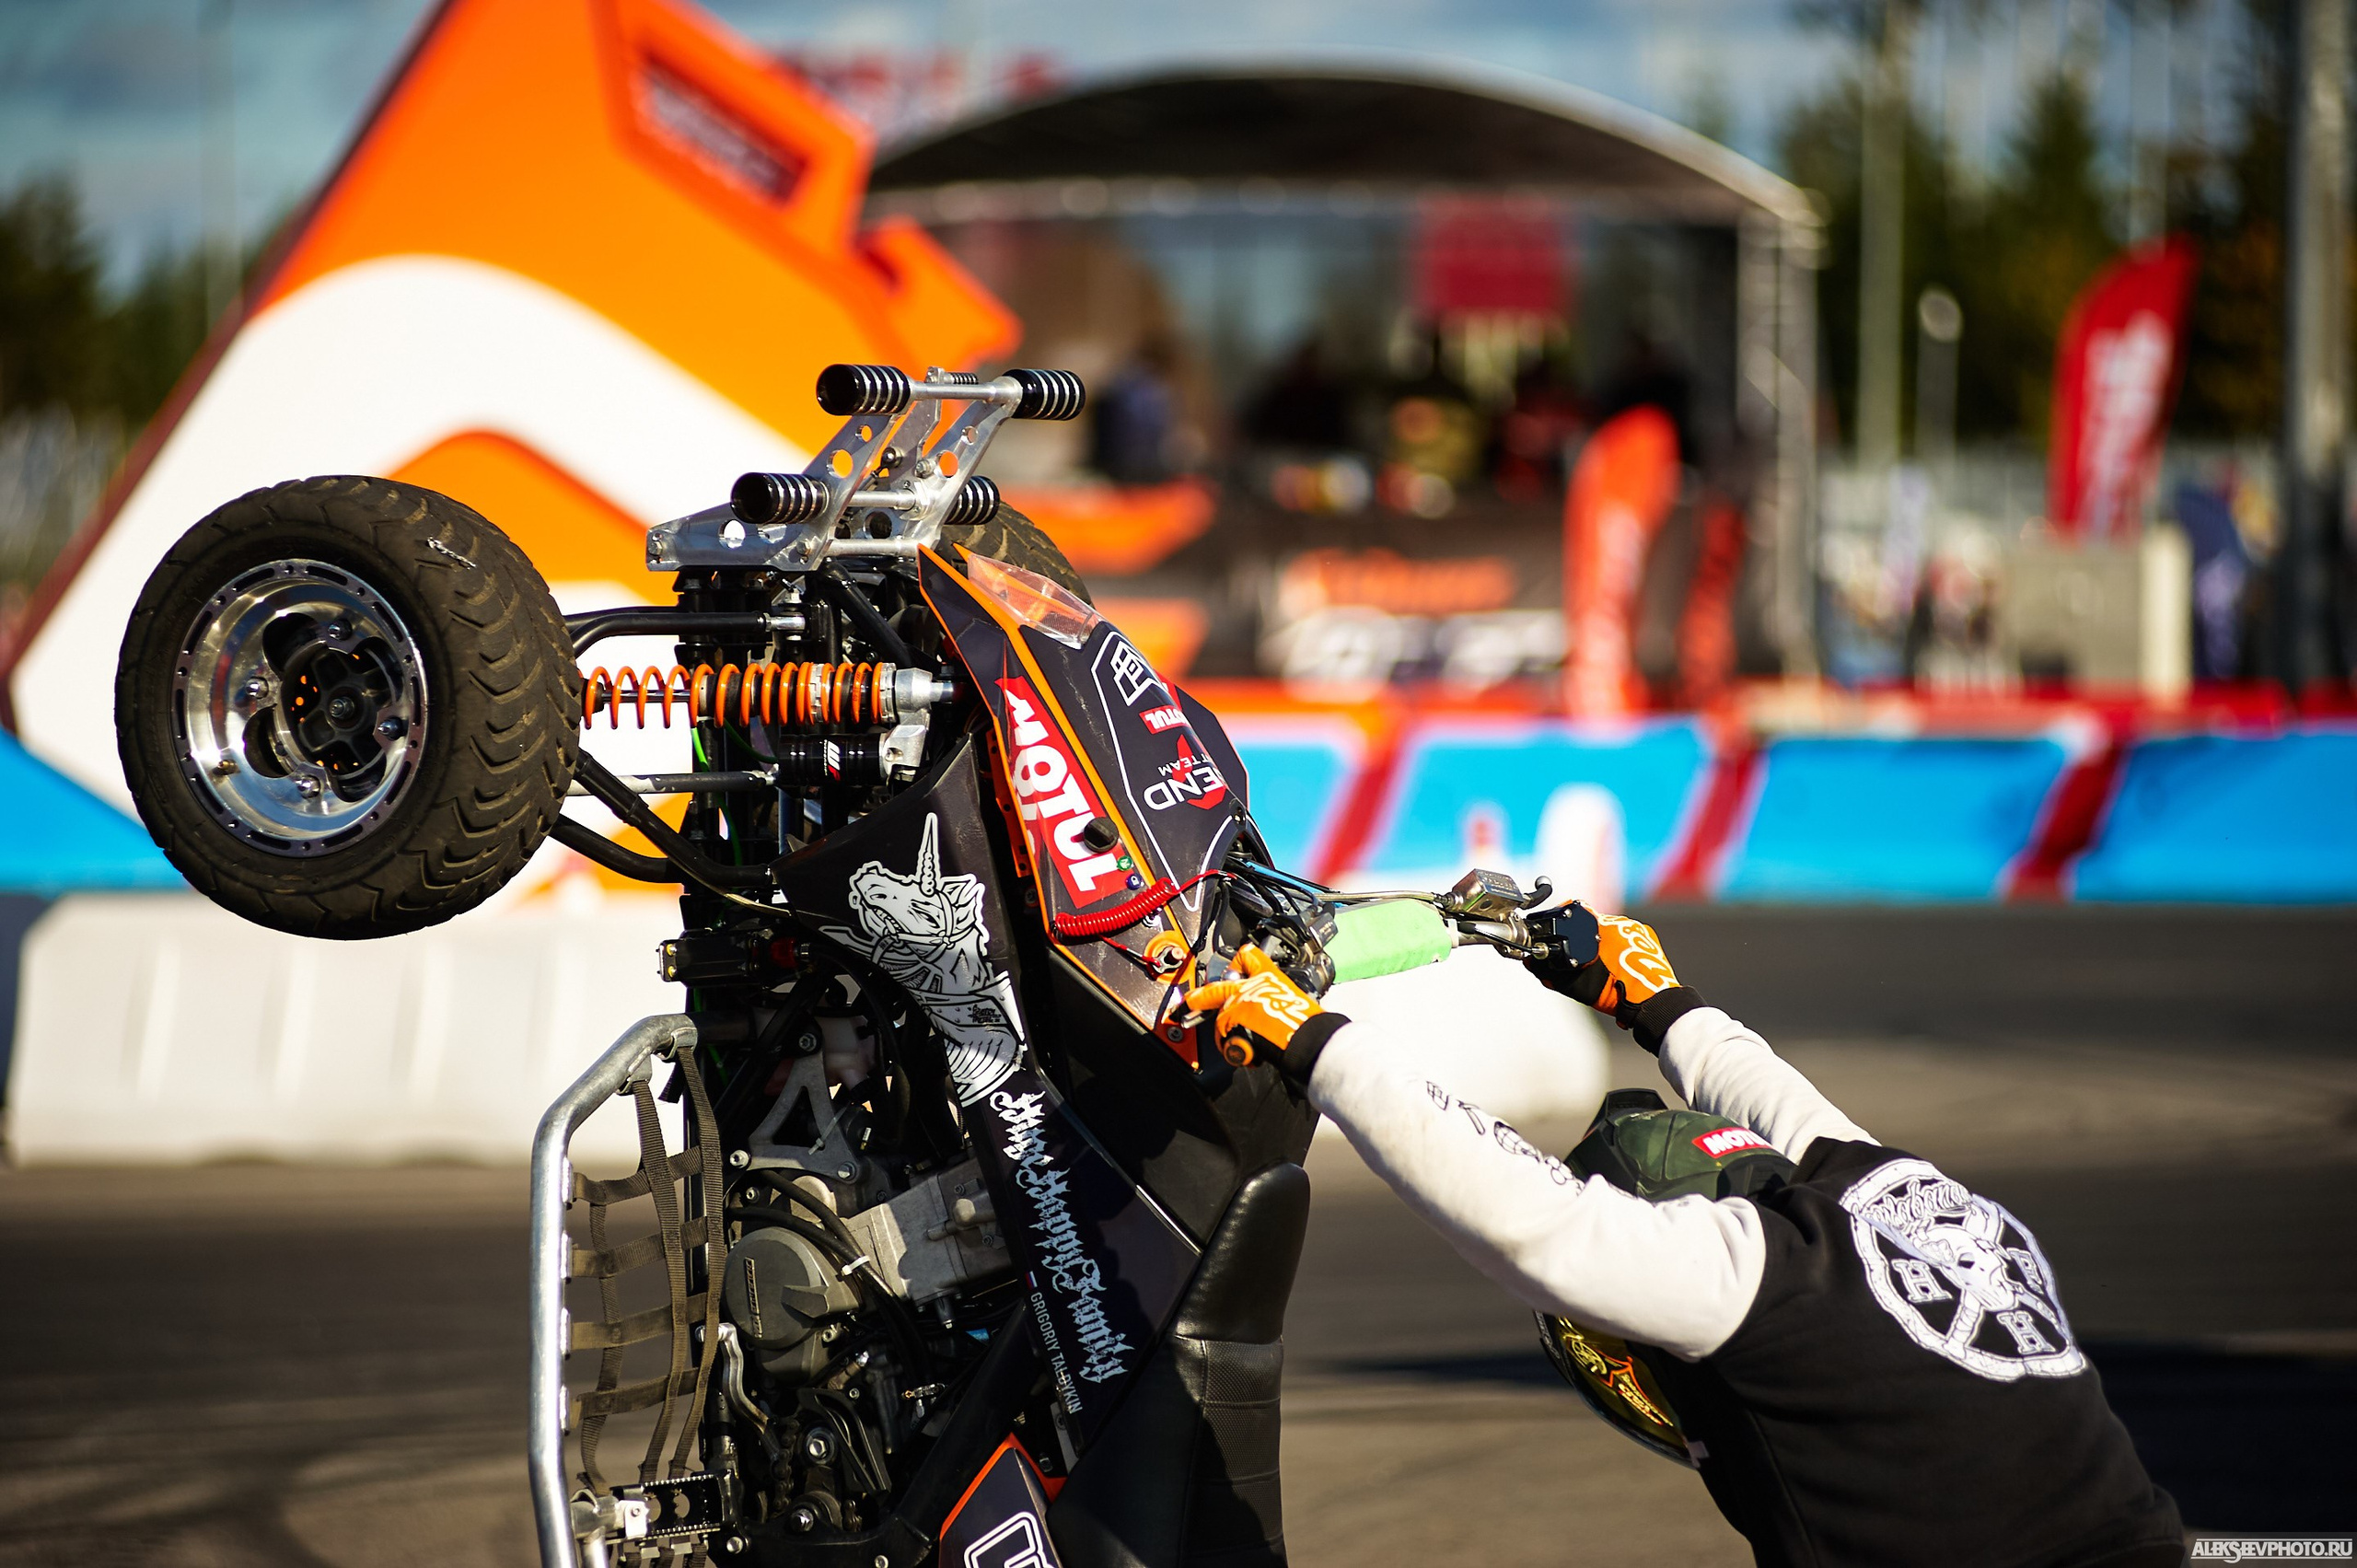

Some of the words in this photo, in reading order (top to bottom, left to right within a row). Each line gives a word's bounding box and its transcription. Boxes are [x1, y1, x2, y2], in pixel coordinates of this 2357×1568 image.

[1144, 708, 1187, 730] OTUL
[1158, 754, 1200, 776] TEAM
[1005, 688, 1119, 892] MOTUL
[1144, 766, 1225, 810] END
[1702, 1129, 1768, 1155] MOTU
[1030, 1292, 1061, 1352] GRIGORIY
